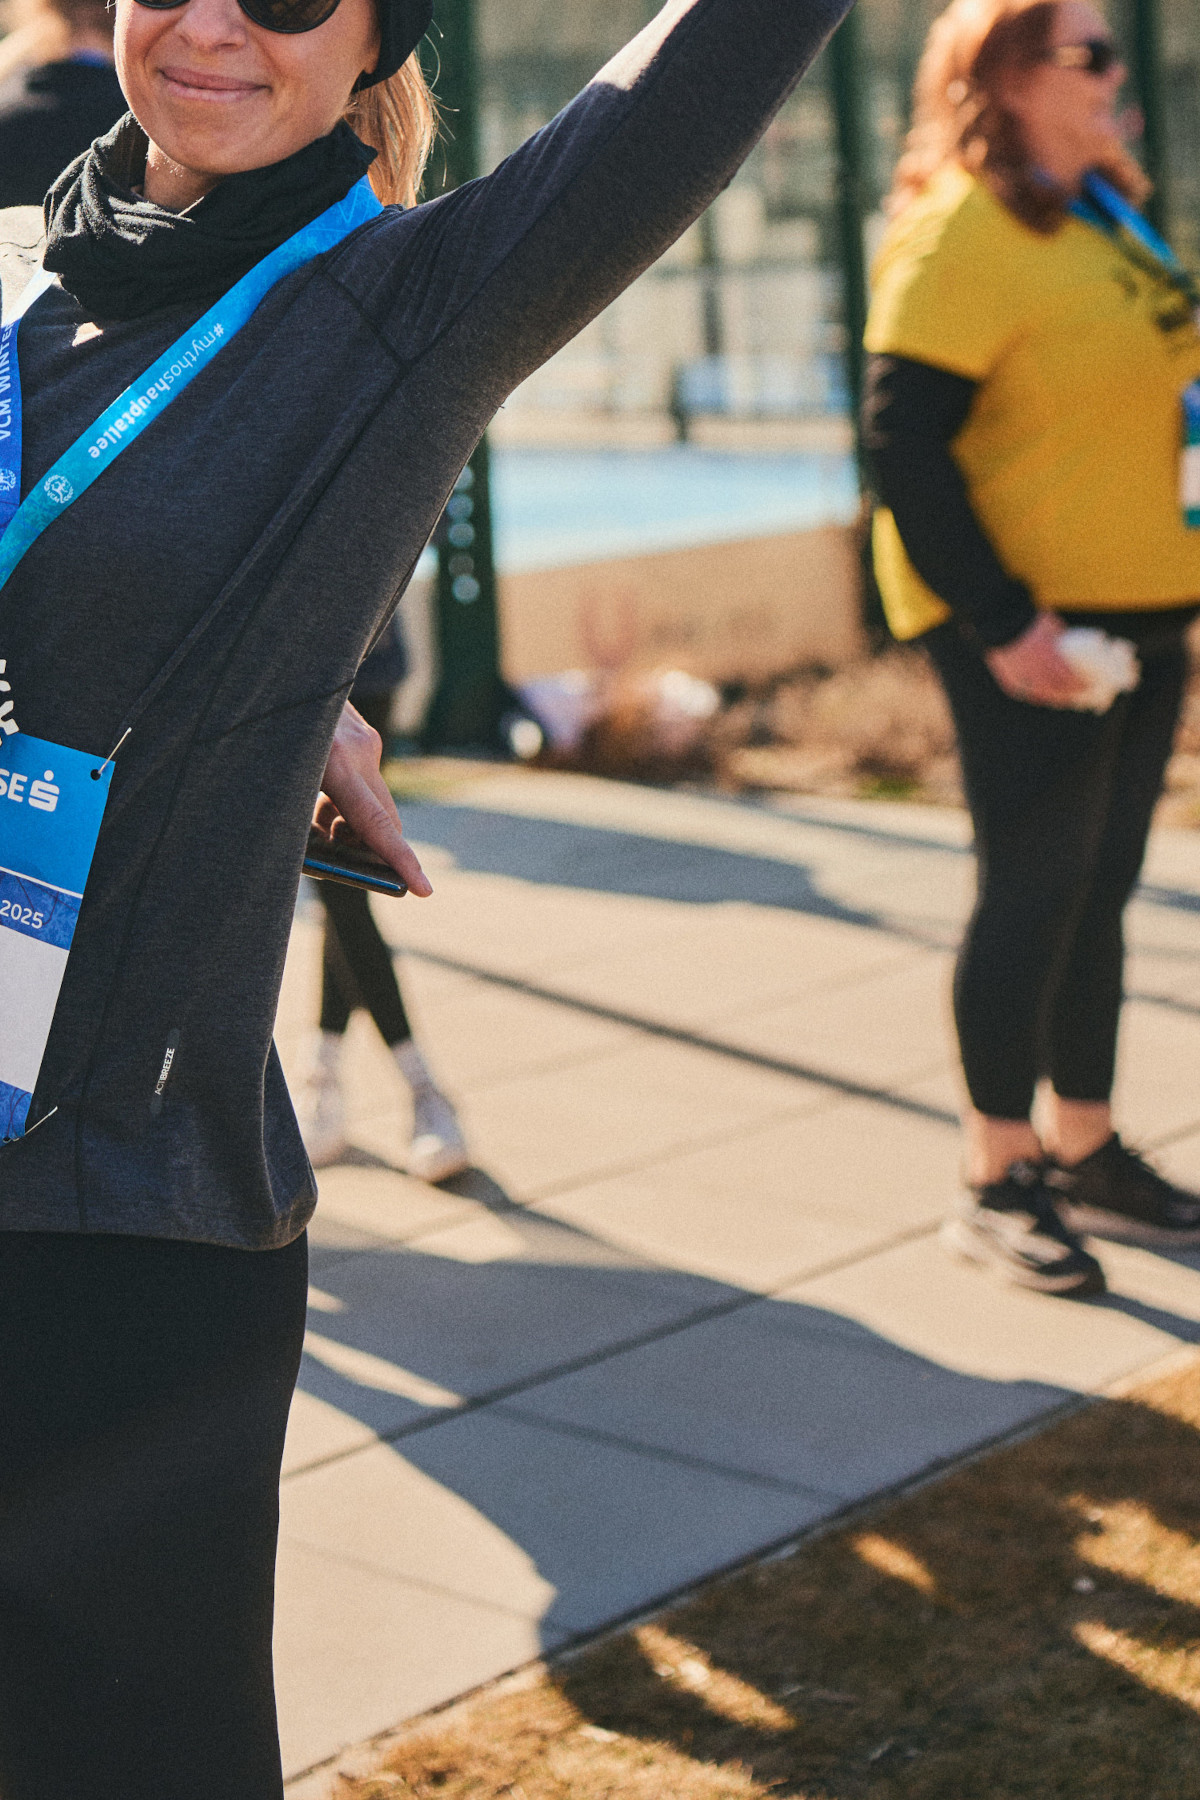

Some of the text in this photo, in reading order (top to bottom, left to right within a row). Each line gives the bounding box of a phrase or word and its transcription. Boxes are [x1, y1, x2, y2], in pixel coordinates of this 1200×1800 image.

[87, 322, 225, 459] #mythoshauptallee
[0, 899, 44, 930] 2025
[154, 1047, 175, 1096] ACTIBREEZE
